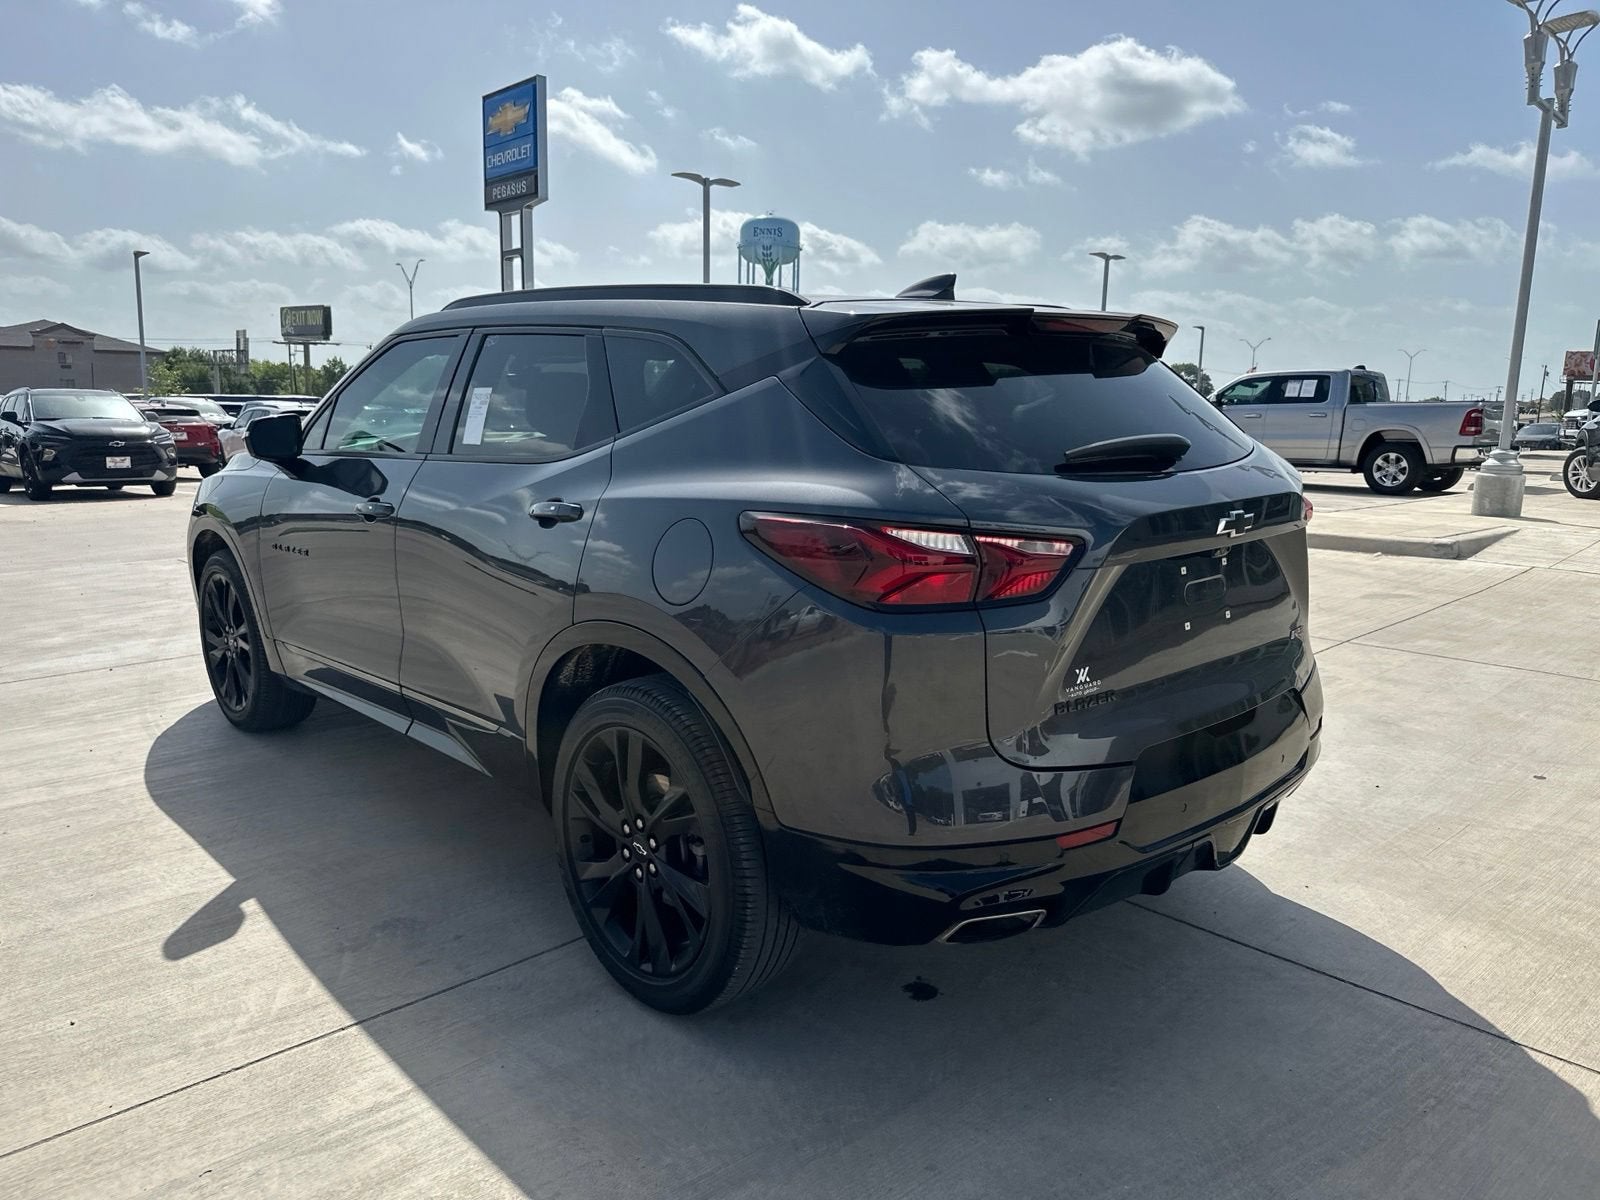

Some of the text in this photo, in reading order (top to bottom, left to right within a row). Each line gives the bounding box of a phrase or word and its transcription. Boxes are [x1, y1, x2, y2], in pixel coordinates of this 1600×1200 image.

[487, 144, 531, 168] CHEVROLET
[492, 180, 527, 199] PEGASUS
[753, 226, 783, 237] ENNIS
[291, 309, 323, 326] EXIT NOW
[1065, 679, 1102, 693] VANGUARD
[1053, 690, 1118, 716] BLAZER
